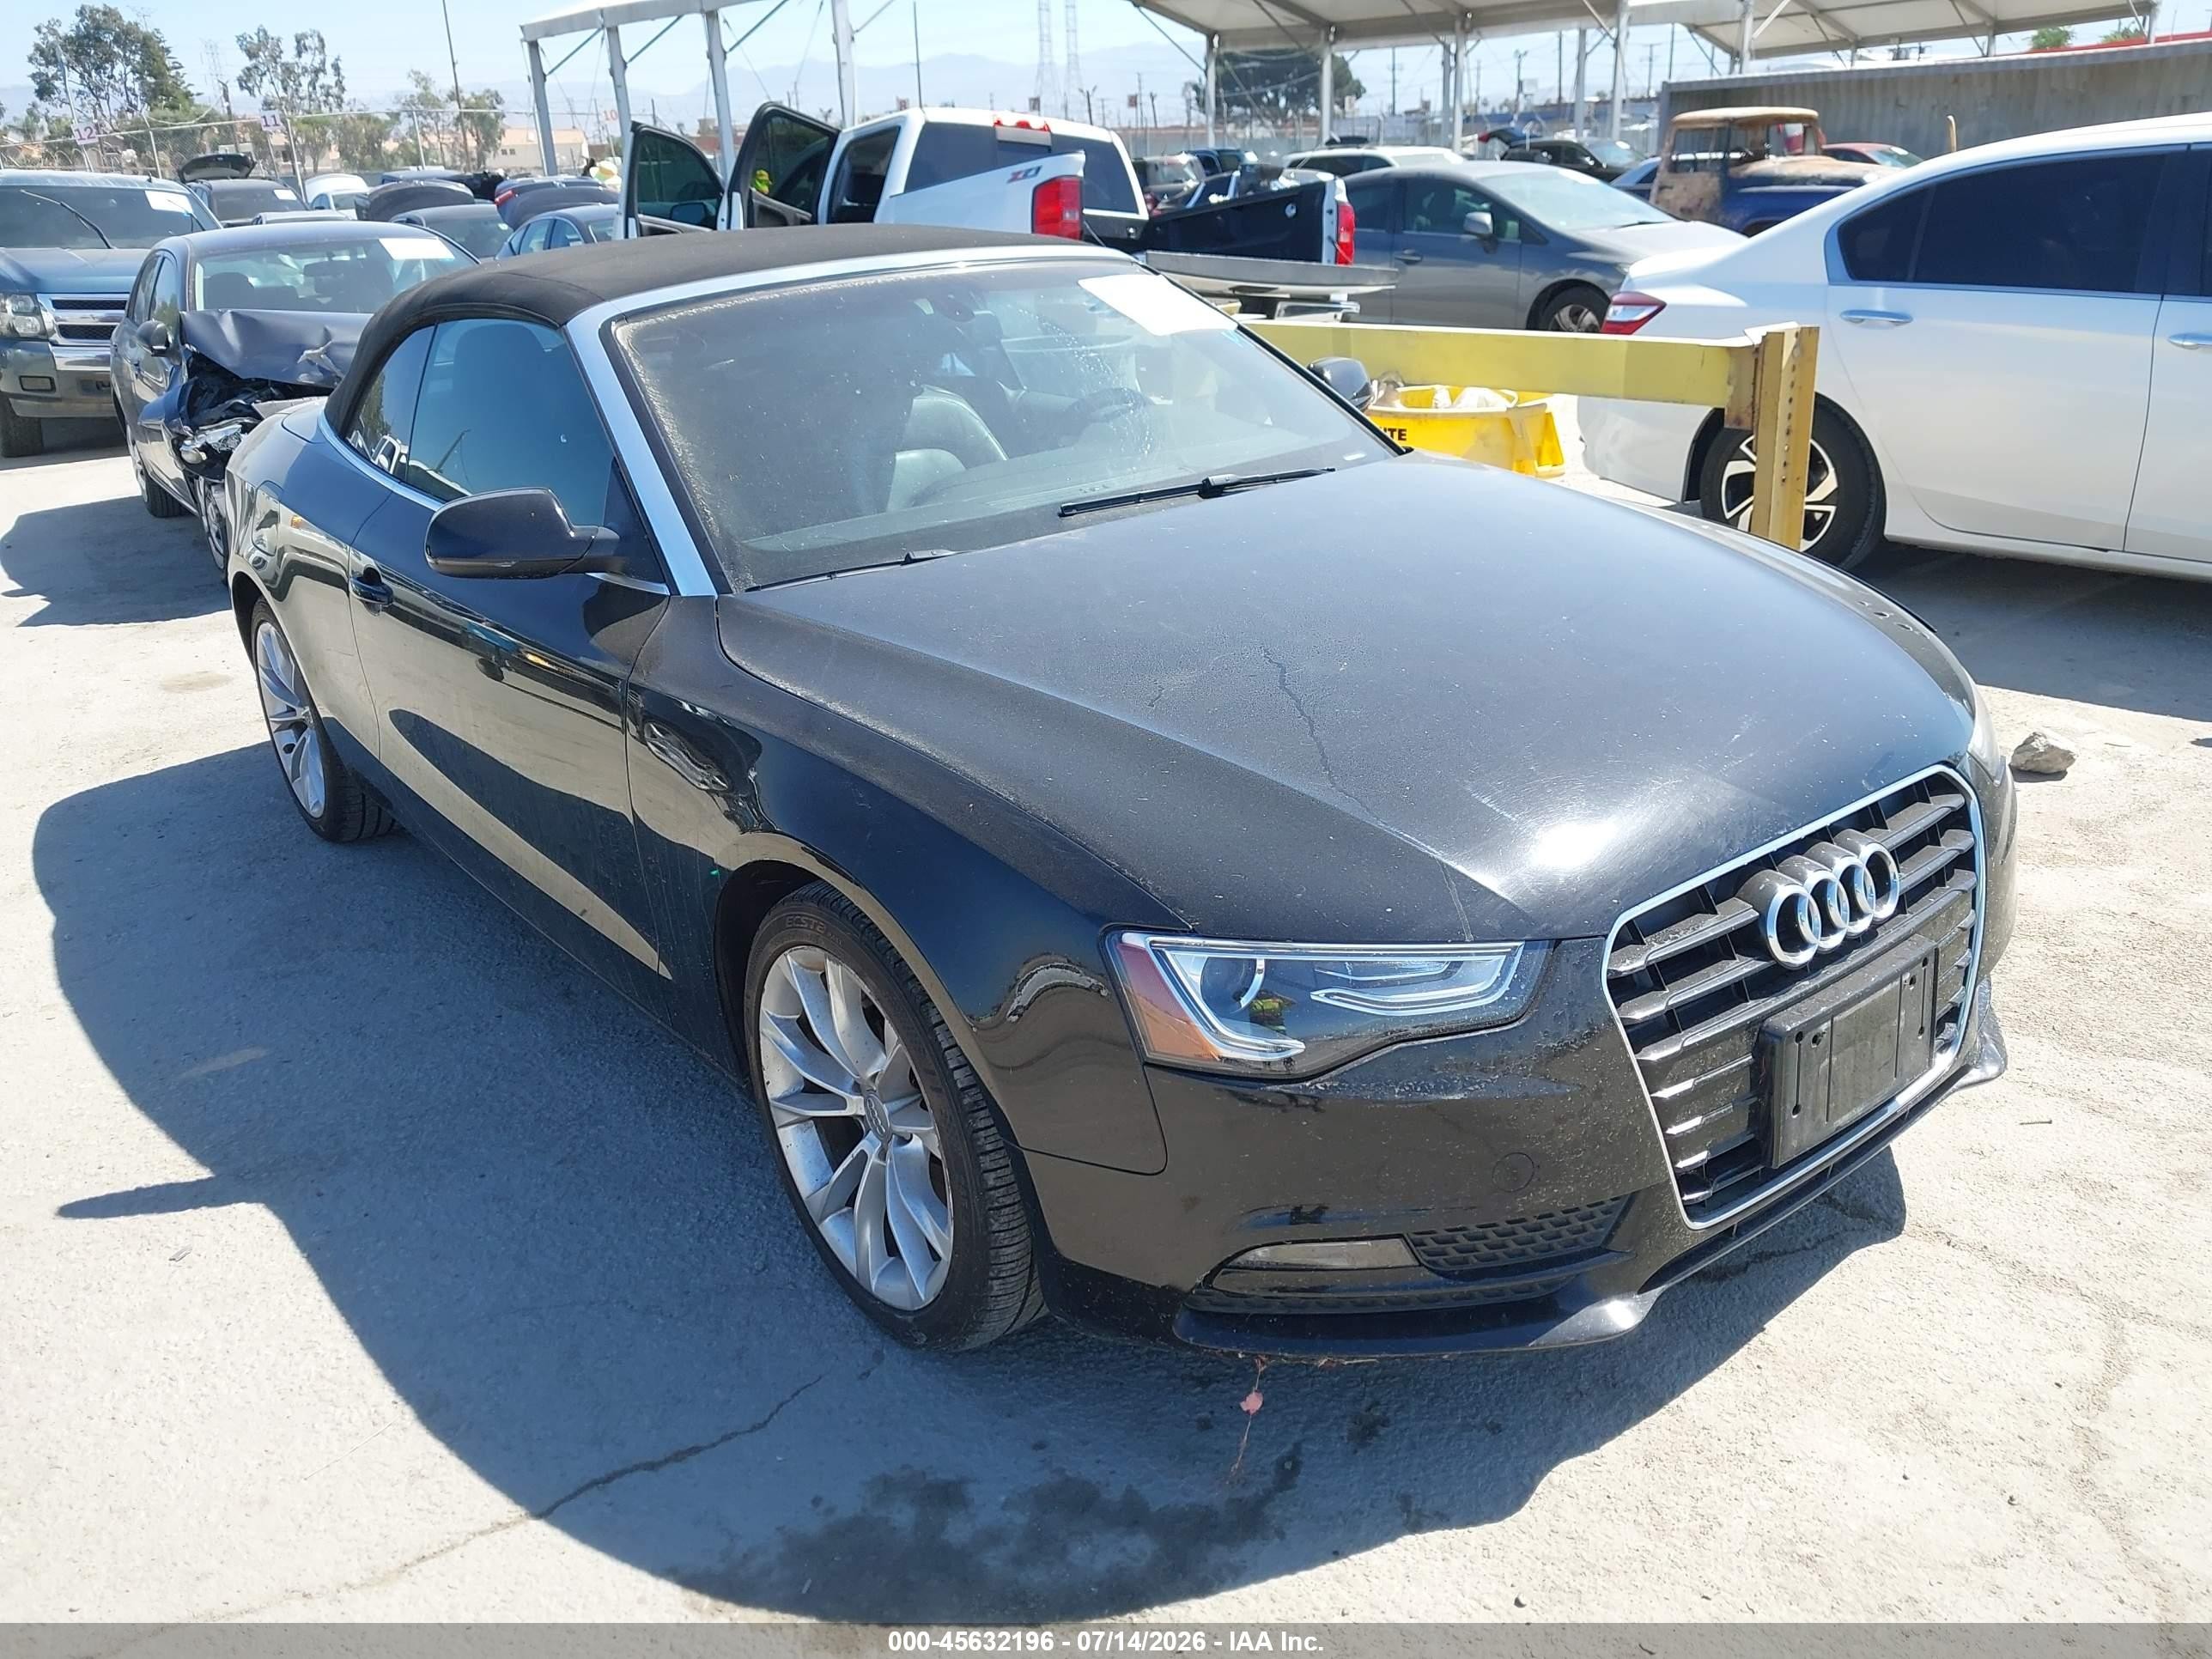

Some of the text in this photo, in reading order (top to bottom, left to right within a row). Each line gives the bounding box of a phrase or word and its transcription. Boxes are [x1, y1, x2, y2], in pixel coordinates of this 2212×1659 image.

[261, 114, 281, 127] 11
[603, 109, 618, 121] 10
[74, 126, 96, 141] 12
